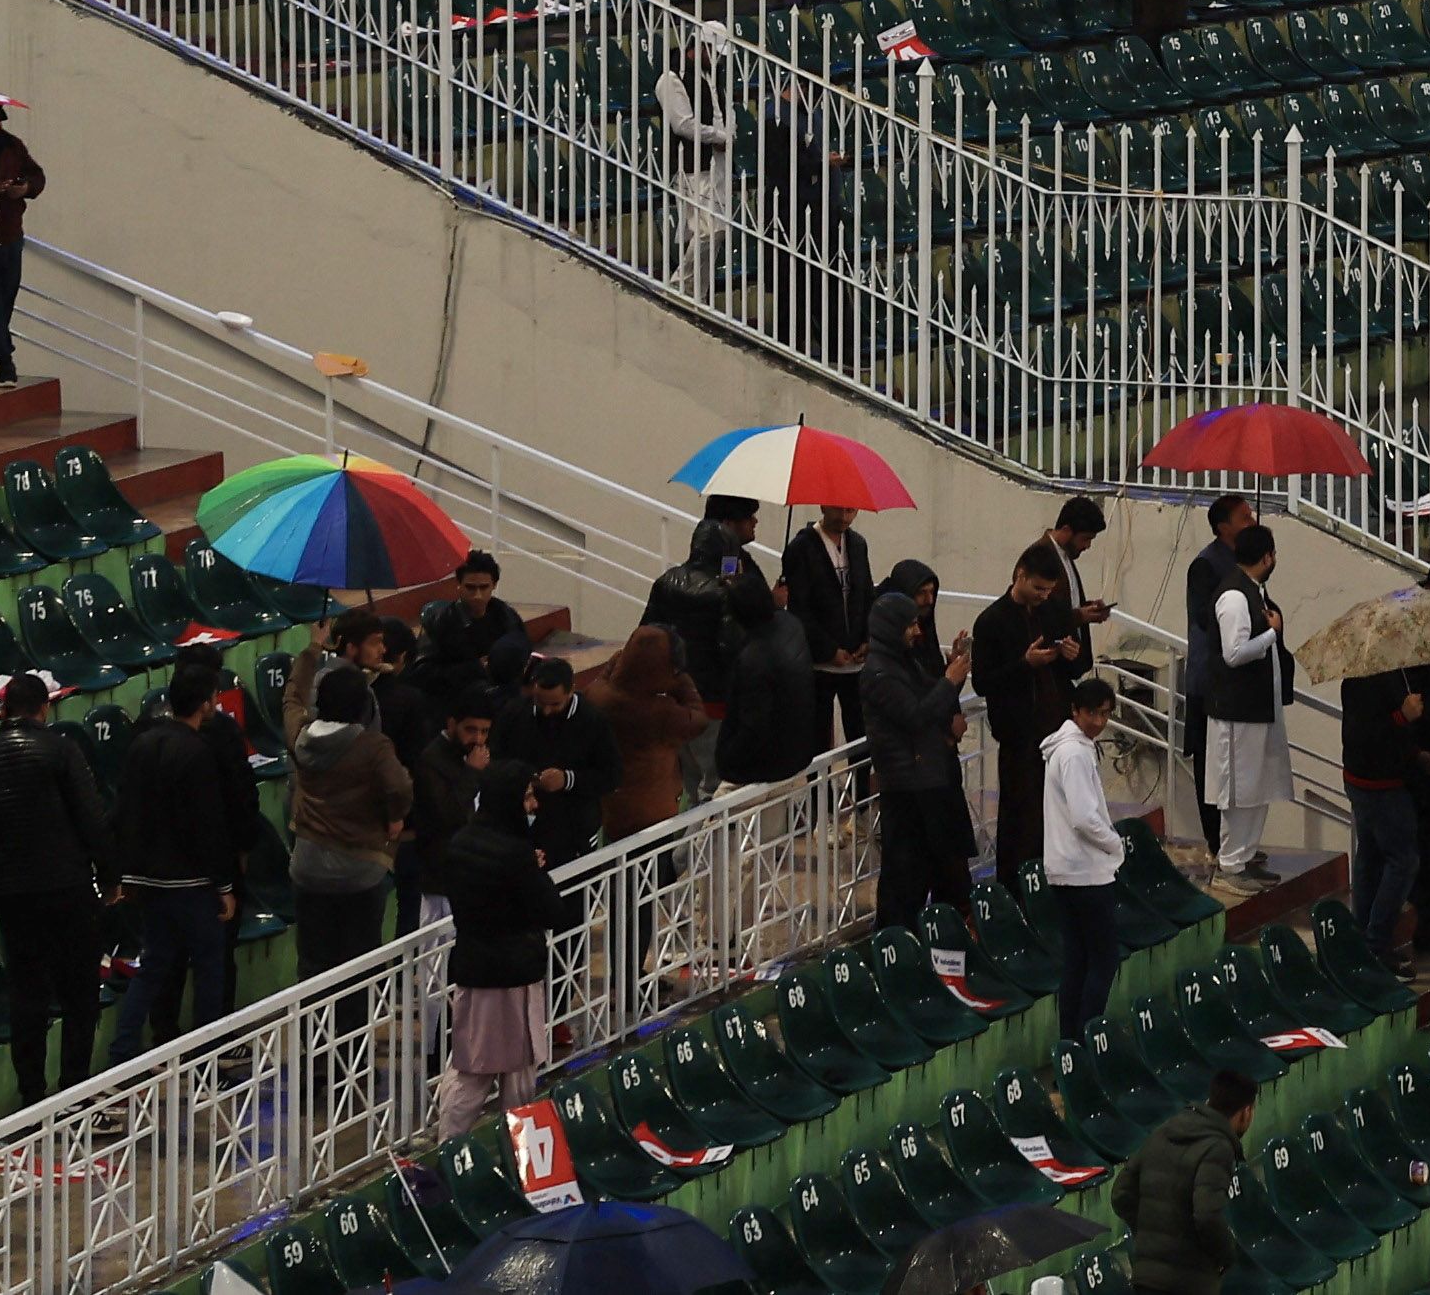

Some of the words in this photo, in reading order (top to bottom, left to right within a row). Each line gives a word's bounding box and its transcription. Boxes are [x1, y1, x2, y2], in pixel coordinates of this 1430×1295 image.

[67, 457, 81, 476] 79
[75, 589, 93, 607] 76
[30, 601, 46, 620] 75
[267, 669, 284, 686] 75
[978, 900, 990, 920] 72
[882, 945, 896, 967] 70
[835, 963, 849, 982] 69
[789, 986, 805, 1007] 68
[677, 1041, 693, 1063] 66
[1094, 1033, 1107, 1054] 70
[1398, 1073, 1414, 1095] 72
[951, 1103, 964, 1126] 67
[901, 1137, 917, 1158] 66
[1275, 1147, 1288, 1169] 69
[855, 1160, 870, 1184] 65
[802, 1186, 818, 1211] 64
[340, 1212, 358, 1235] 60
[284, 1241, 303, 1267] 59
